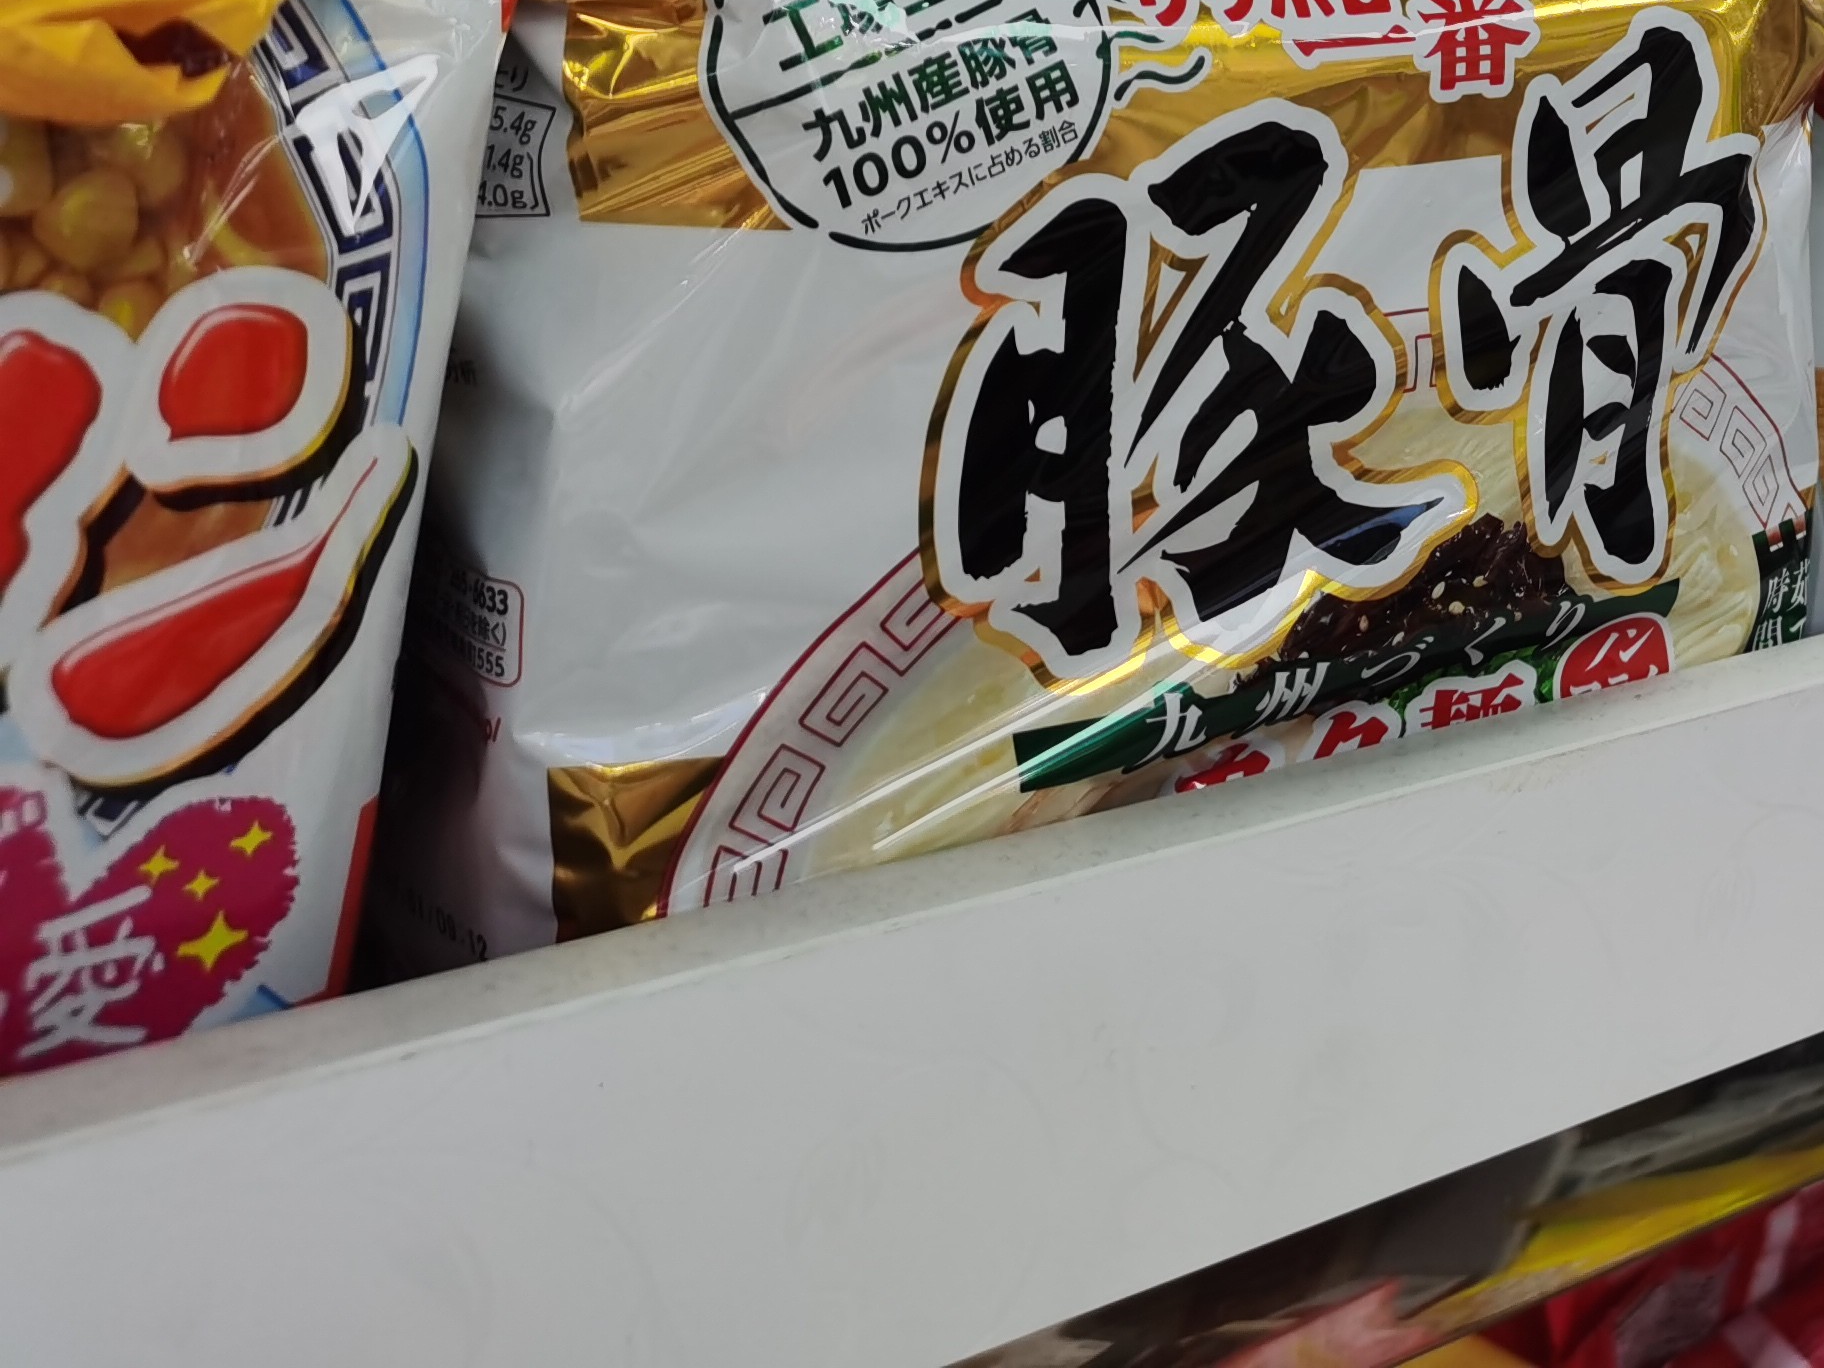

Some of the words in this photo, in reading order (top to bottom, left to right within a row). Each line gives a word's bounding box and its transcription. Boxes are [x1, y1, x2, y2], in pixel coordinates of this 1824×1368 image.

[802, 11, 1059, 164] 九州産豚骨
[822, 67, 1081, 210] 100%使用
[861, 118, 1081, 236] ポークエキスに占める割合
[957, 26, 1757, 656] 豚骨
[1140, 598, 1588, 768] 九州づくり
